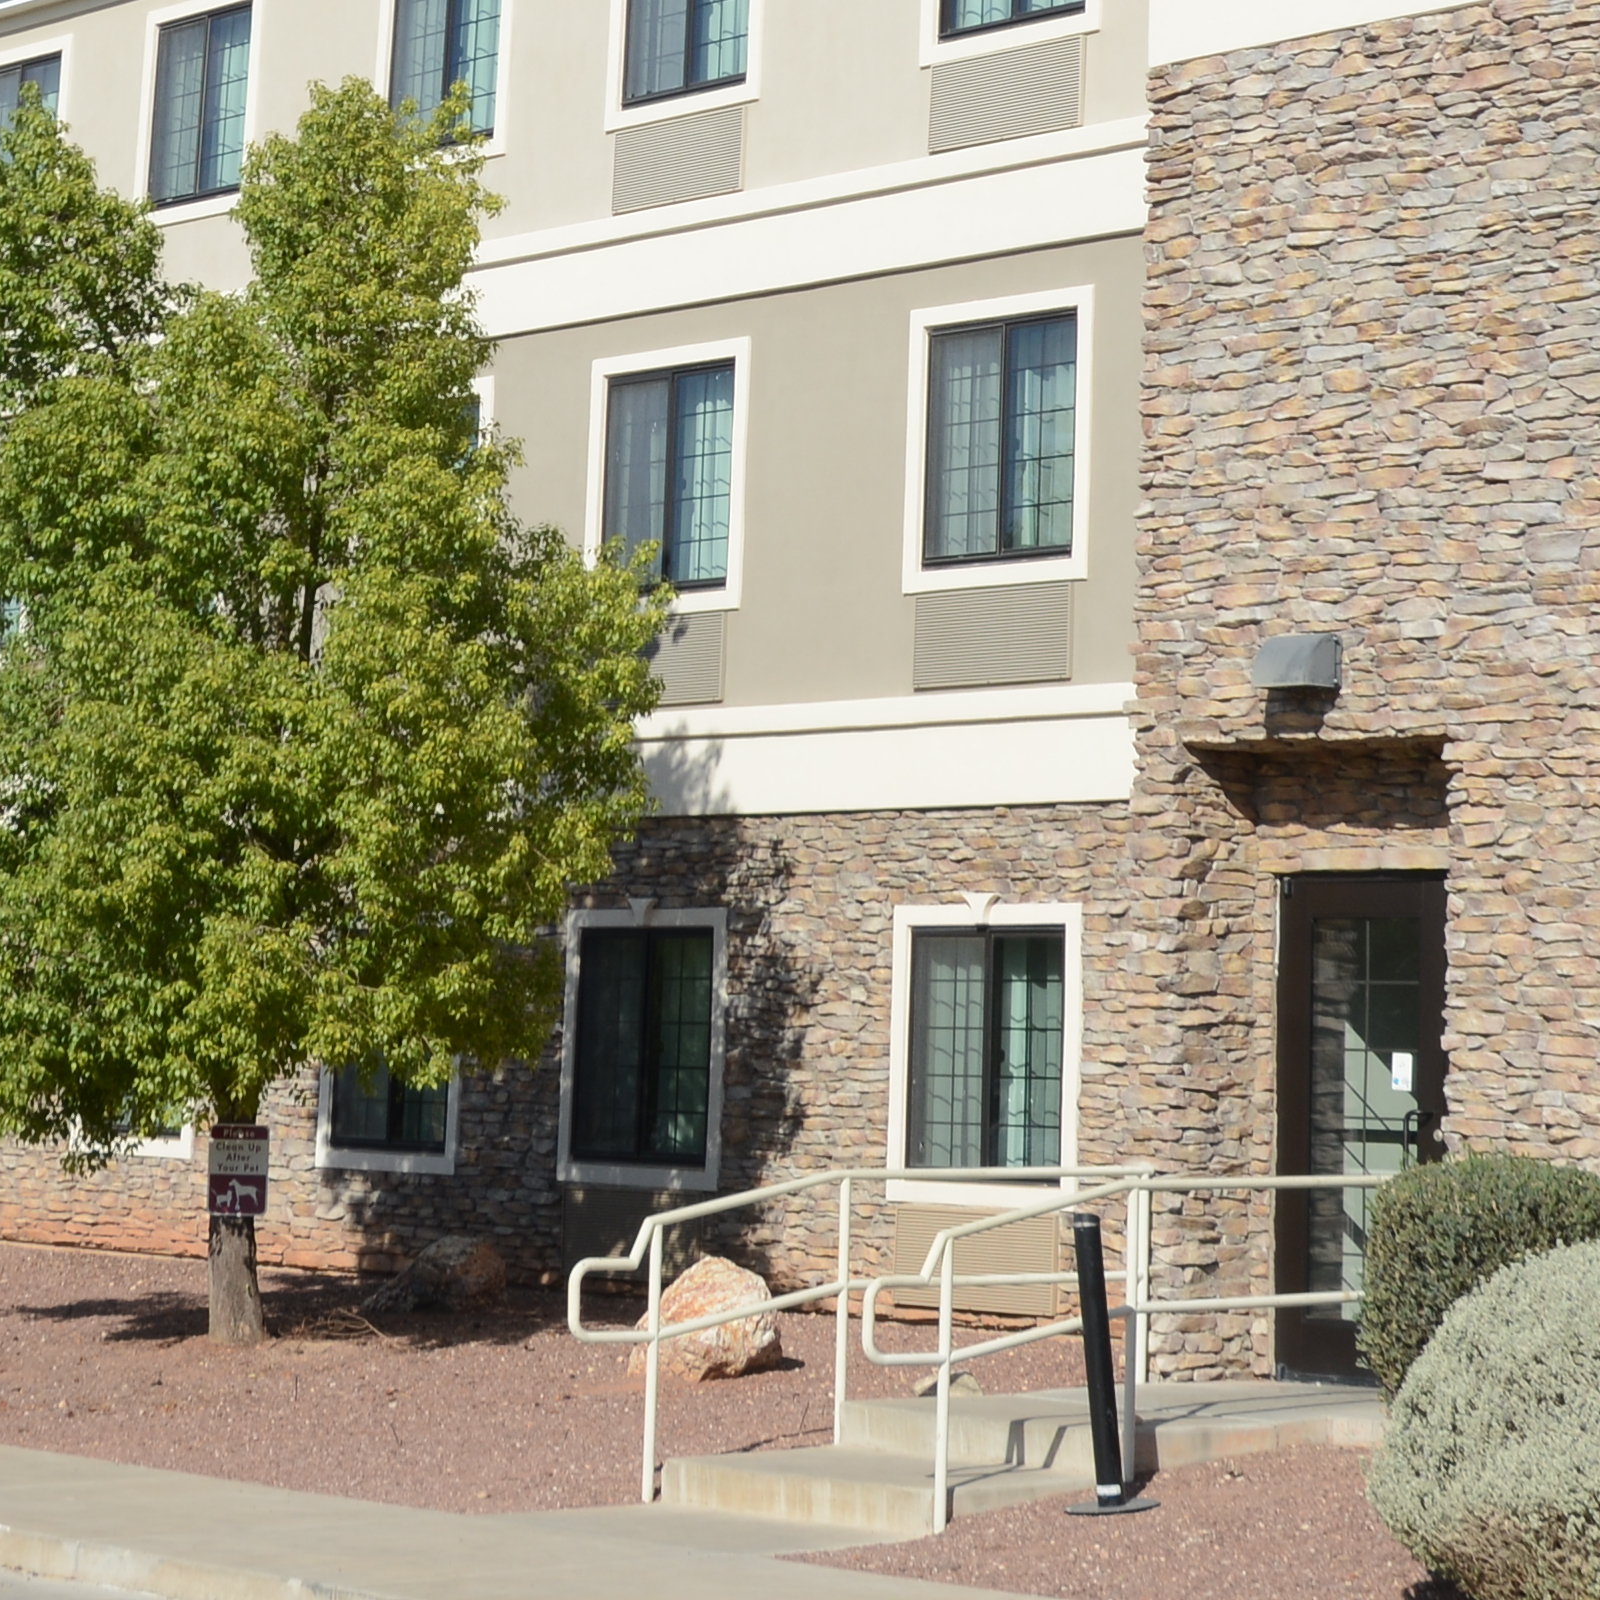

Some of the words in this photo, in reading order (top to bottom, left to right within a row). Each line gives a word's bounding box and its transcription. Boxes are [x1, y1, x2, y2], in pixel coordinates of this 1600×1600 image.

[223, 1127, 255, 1138] Plese
[215, 1141, 244, 1151] Clean
[248, 1143, 262, 1154] Up
[225, 1152, 250, 1162] After
[217, 1163, 238, 1171] Your
[243, 1163, 259, 1172] Pet
